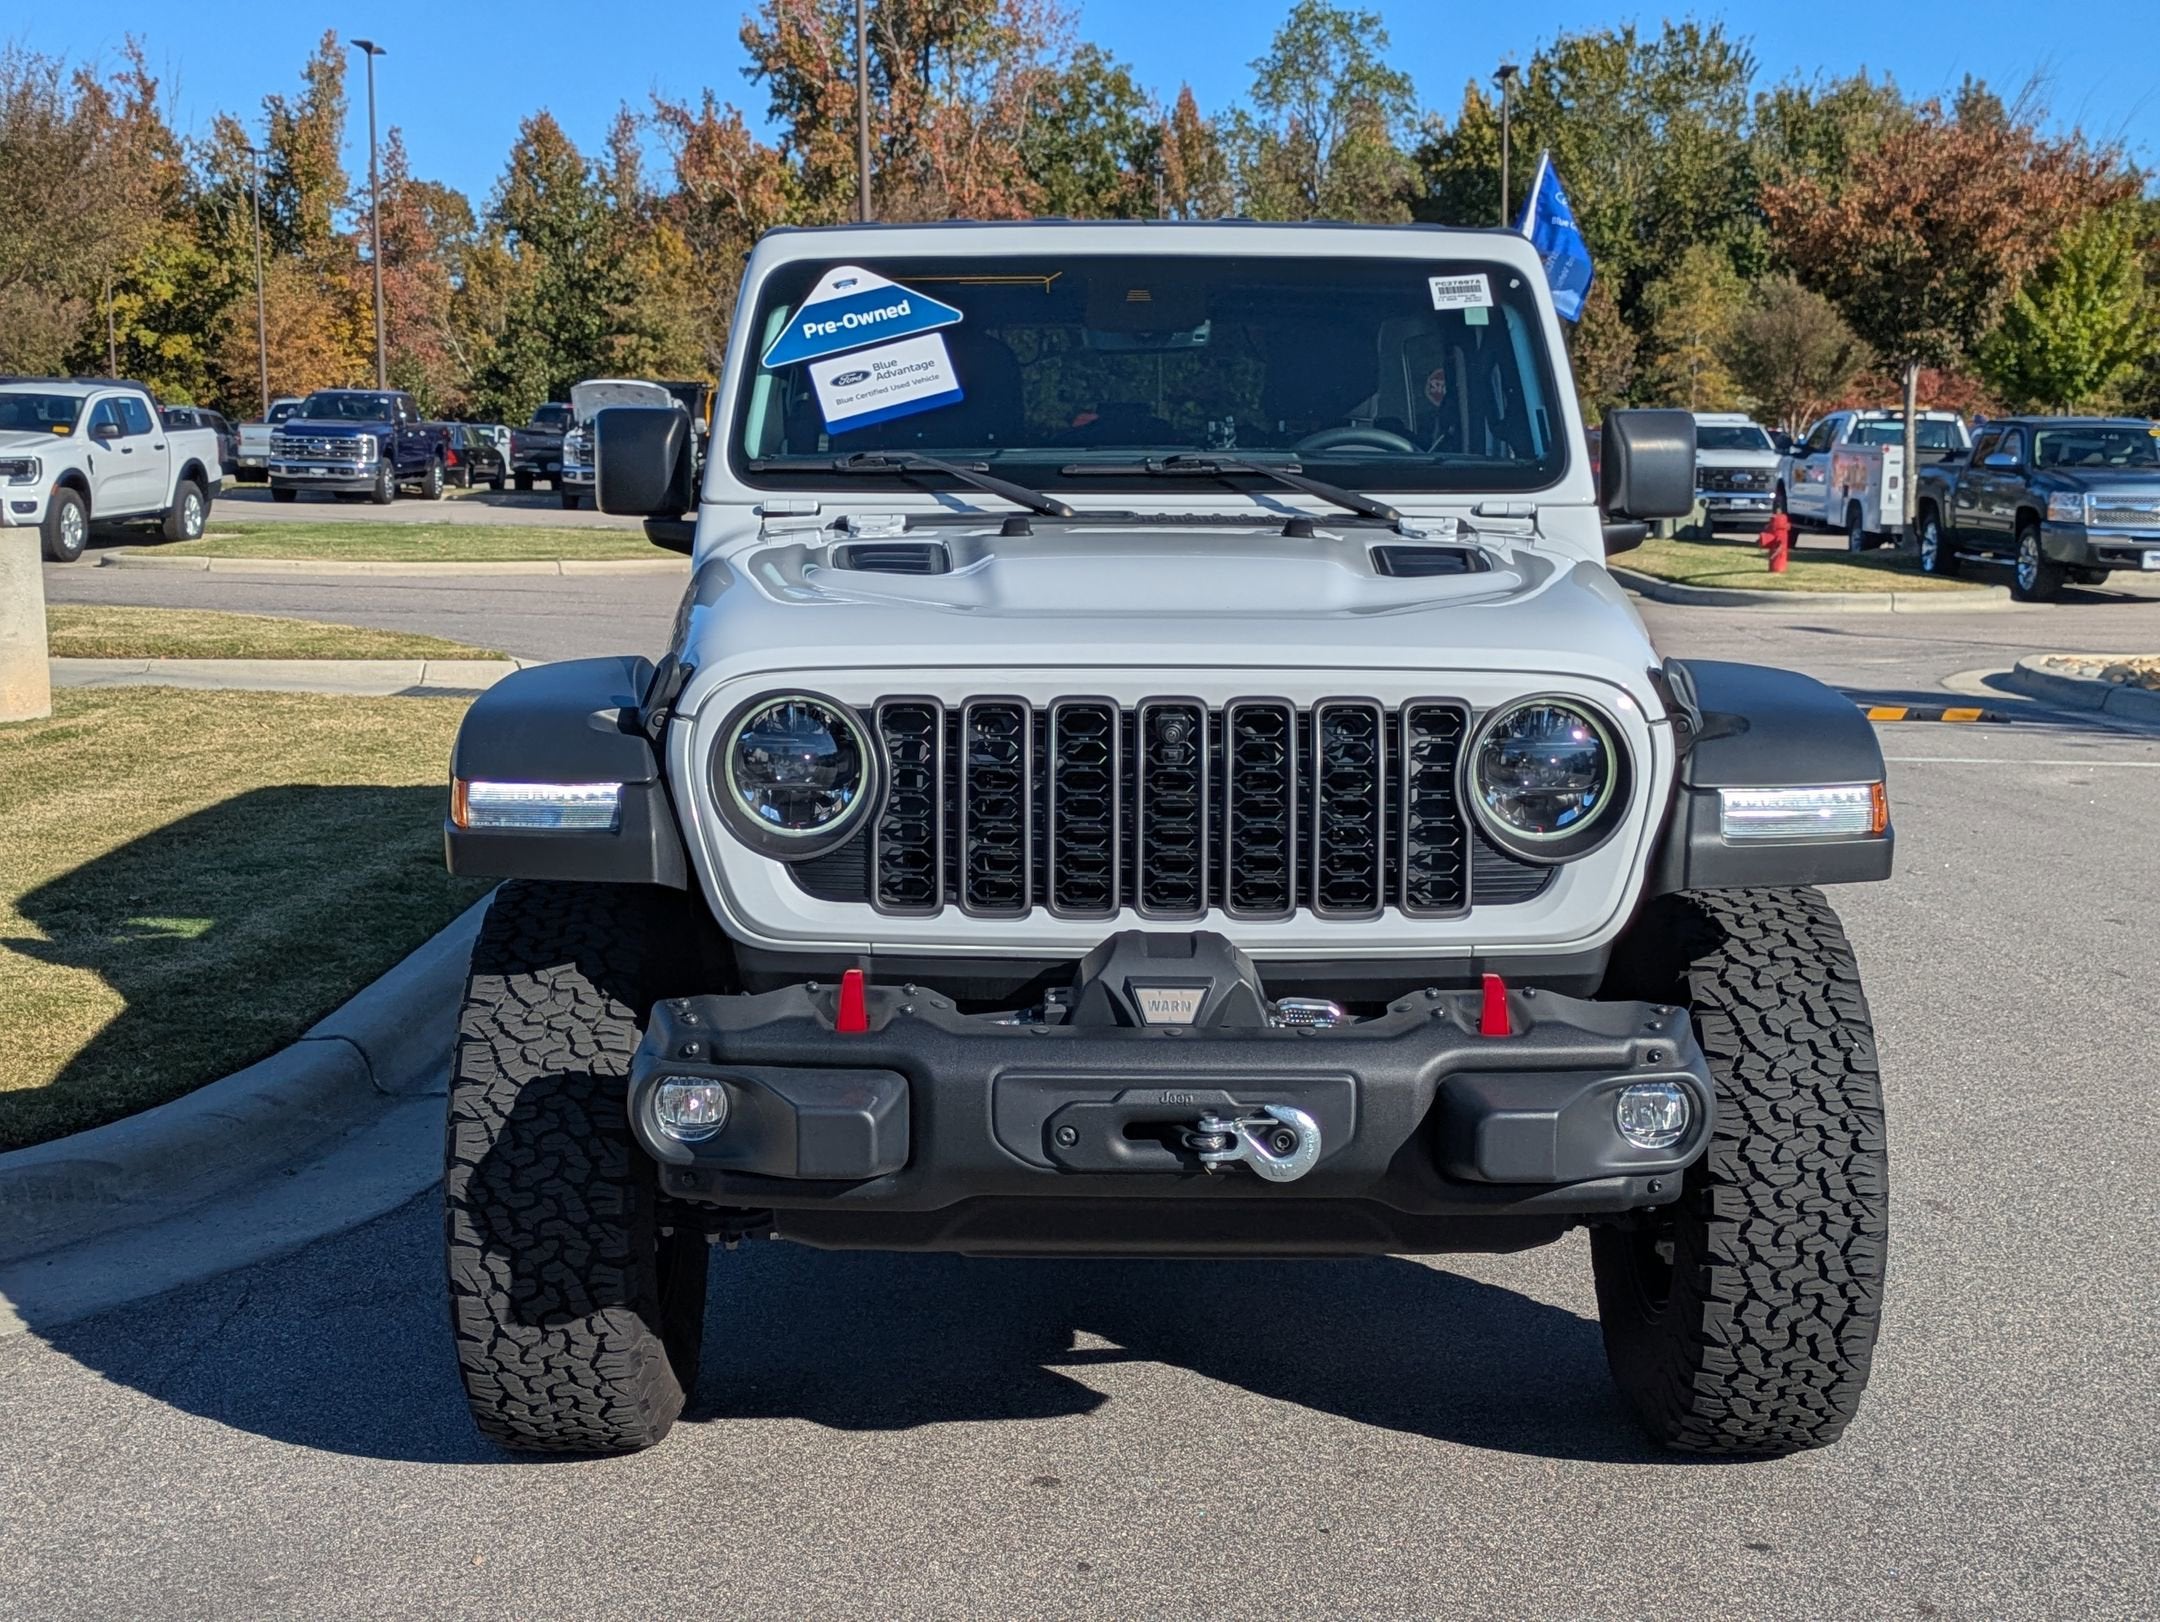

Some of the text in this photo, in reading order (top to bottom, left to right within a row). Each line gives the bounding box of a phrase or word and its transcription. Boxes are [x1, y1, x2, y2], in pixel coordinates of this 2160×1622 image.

[803, 300, 911, 339] Pre-Owned
[837, 360, 935, 386] Ford Advantage
[872, 360, 898, 372] Blue
[836, 374, 940, 406] Blue Certified Used Vehicle
[1148, 1000, 1192, 1012] WARN
[1159, 1090, 1194, 1106] Jeep
